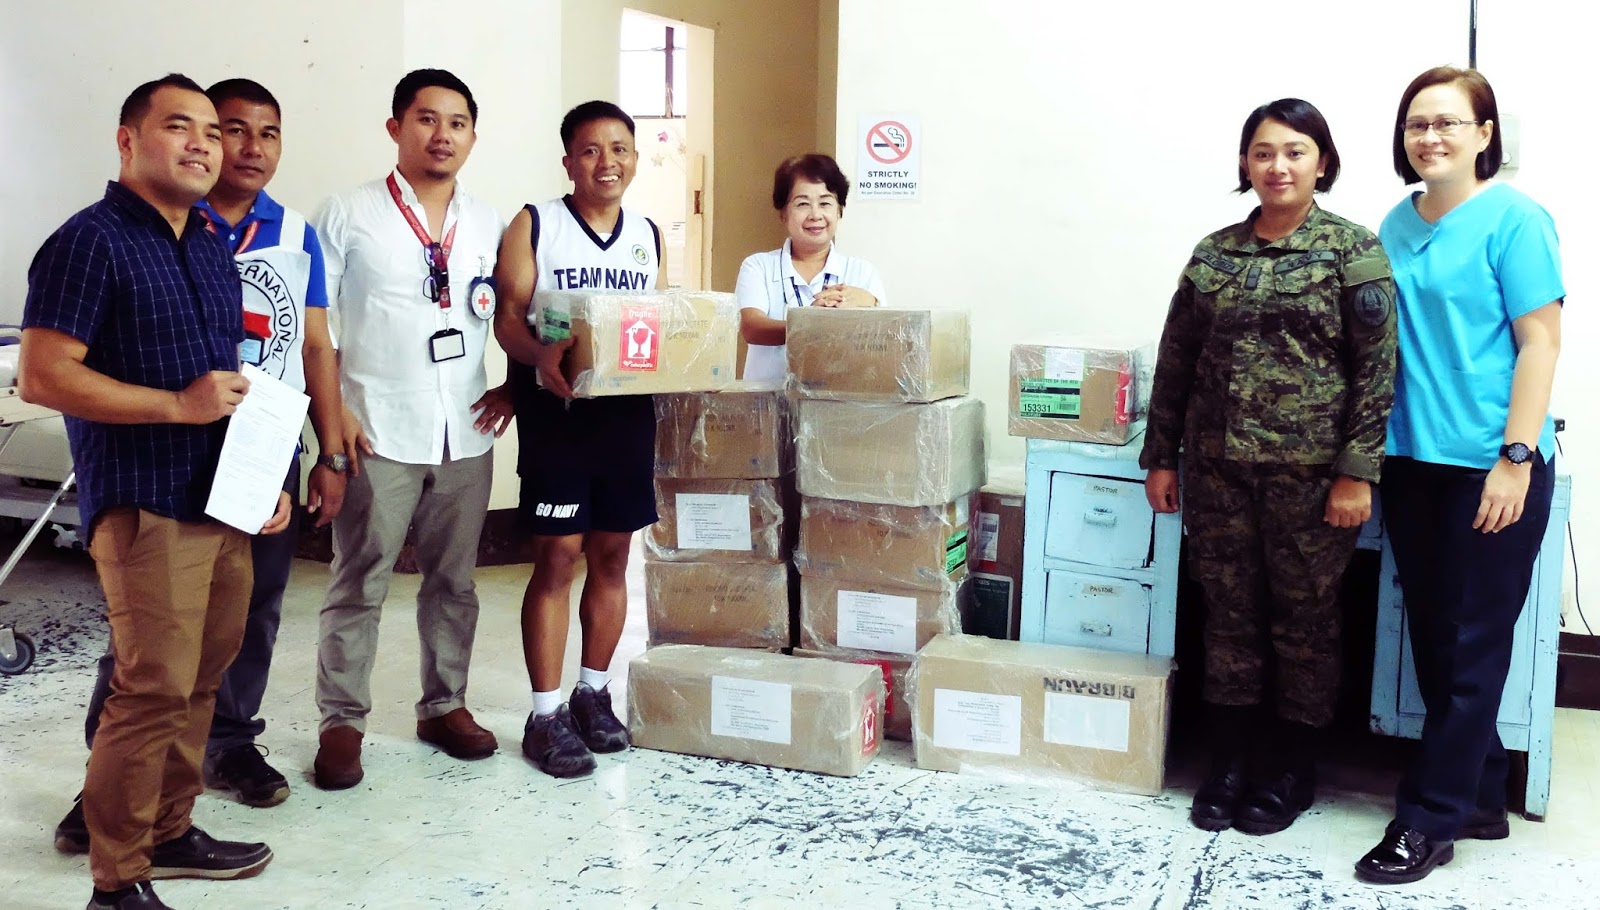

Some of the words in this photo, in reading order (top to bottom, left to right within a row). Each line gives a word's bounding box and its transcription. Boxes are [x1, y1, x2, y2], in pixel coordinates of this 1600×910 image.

[1287, 251, 1323, 268] NAVY
[553, 267, 602, 291] TEAM
[605, 268, 649, 291] NAVY
[1023, 403, 1052, 413] 153331
[1093, 485, 1118, 494] PASTOR
[535, 502, 553, 517] GO
[551, 503, 580, 518] NAVY
[1089, 585, 1114, 594] PASTOR
